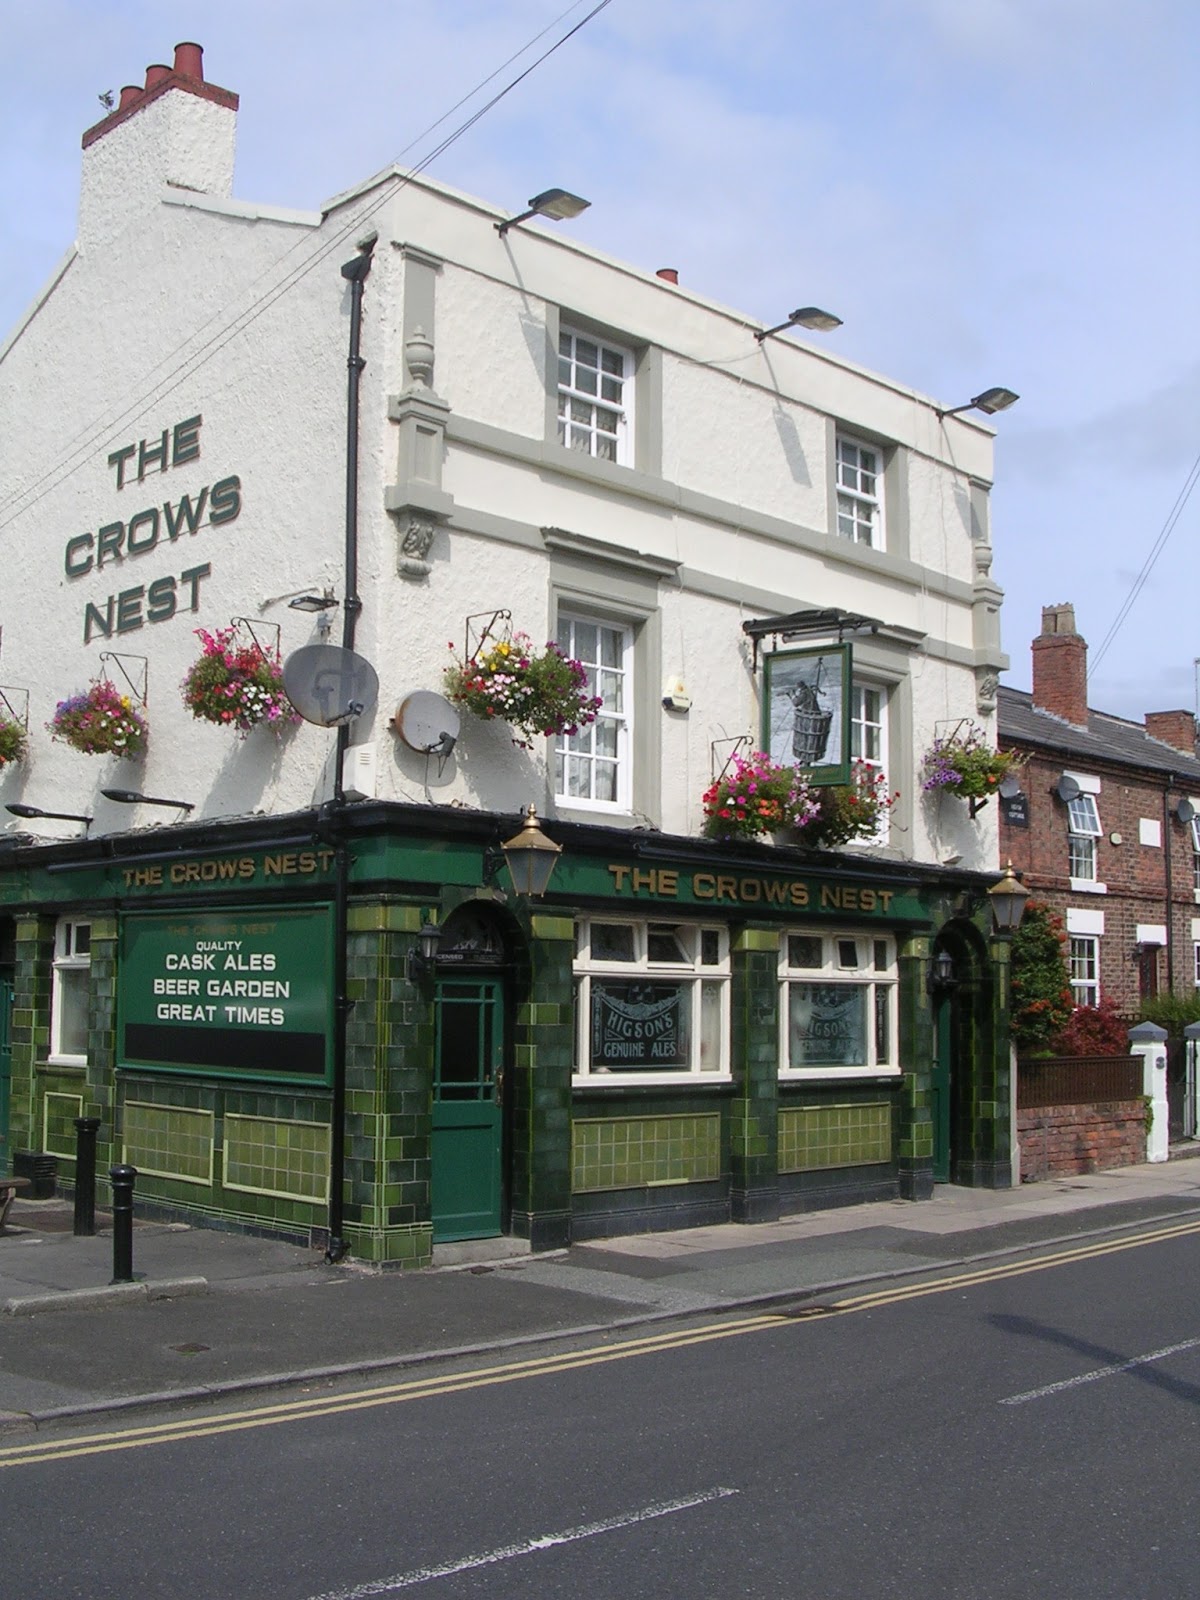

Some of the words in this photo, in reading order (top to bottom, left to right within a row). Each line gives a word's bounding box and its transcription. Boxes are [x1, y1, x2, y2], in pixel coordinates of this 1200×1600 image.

[108, 413, 203, 490] THE
[65, 475, 241, 578] CROWS
[83, 562, 211, 644] NEST
[122, 866, 163, 888] THE
[170, 857, 256, 884] CROWS
[263, 850, 335, 876] NEST
[607, 864, 680, 895] THE
[693, 873, 809, 905] CROWS
[820, 885, 894, 912] NEST
[196, 941, 242, 952] QUALITY
[166, 954, 216, 971] CASK
[223, 954, 276, 971] ALES
[153, 979, 200, 996] BEER
[207, 980, 290, 998] GARDEN
[157, 1003, 217, 1022] GREAT
[225, 1006, 285, 1026] TIMES
[607, 1011, 674, 1038] HIGSON'S
[603, 1042, 645, 1058] GENUINE
[651, 1042, 677, 1057] ALES
